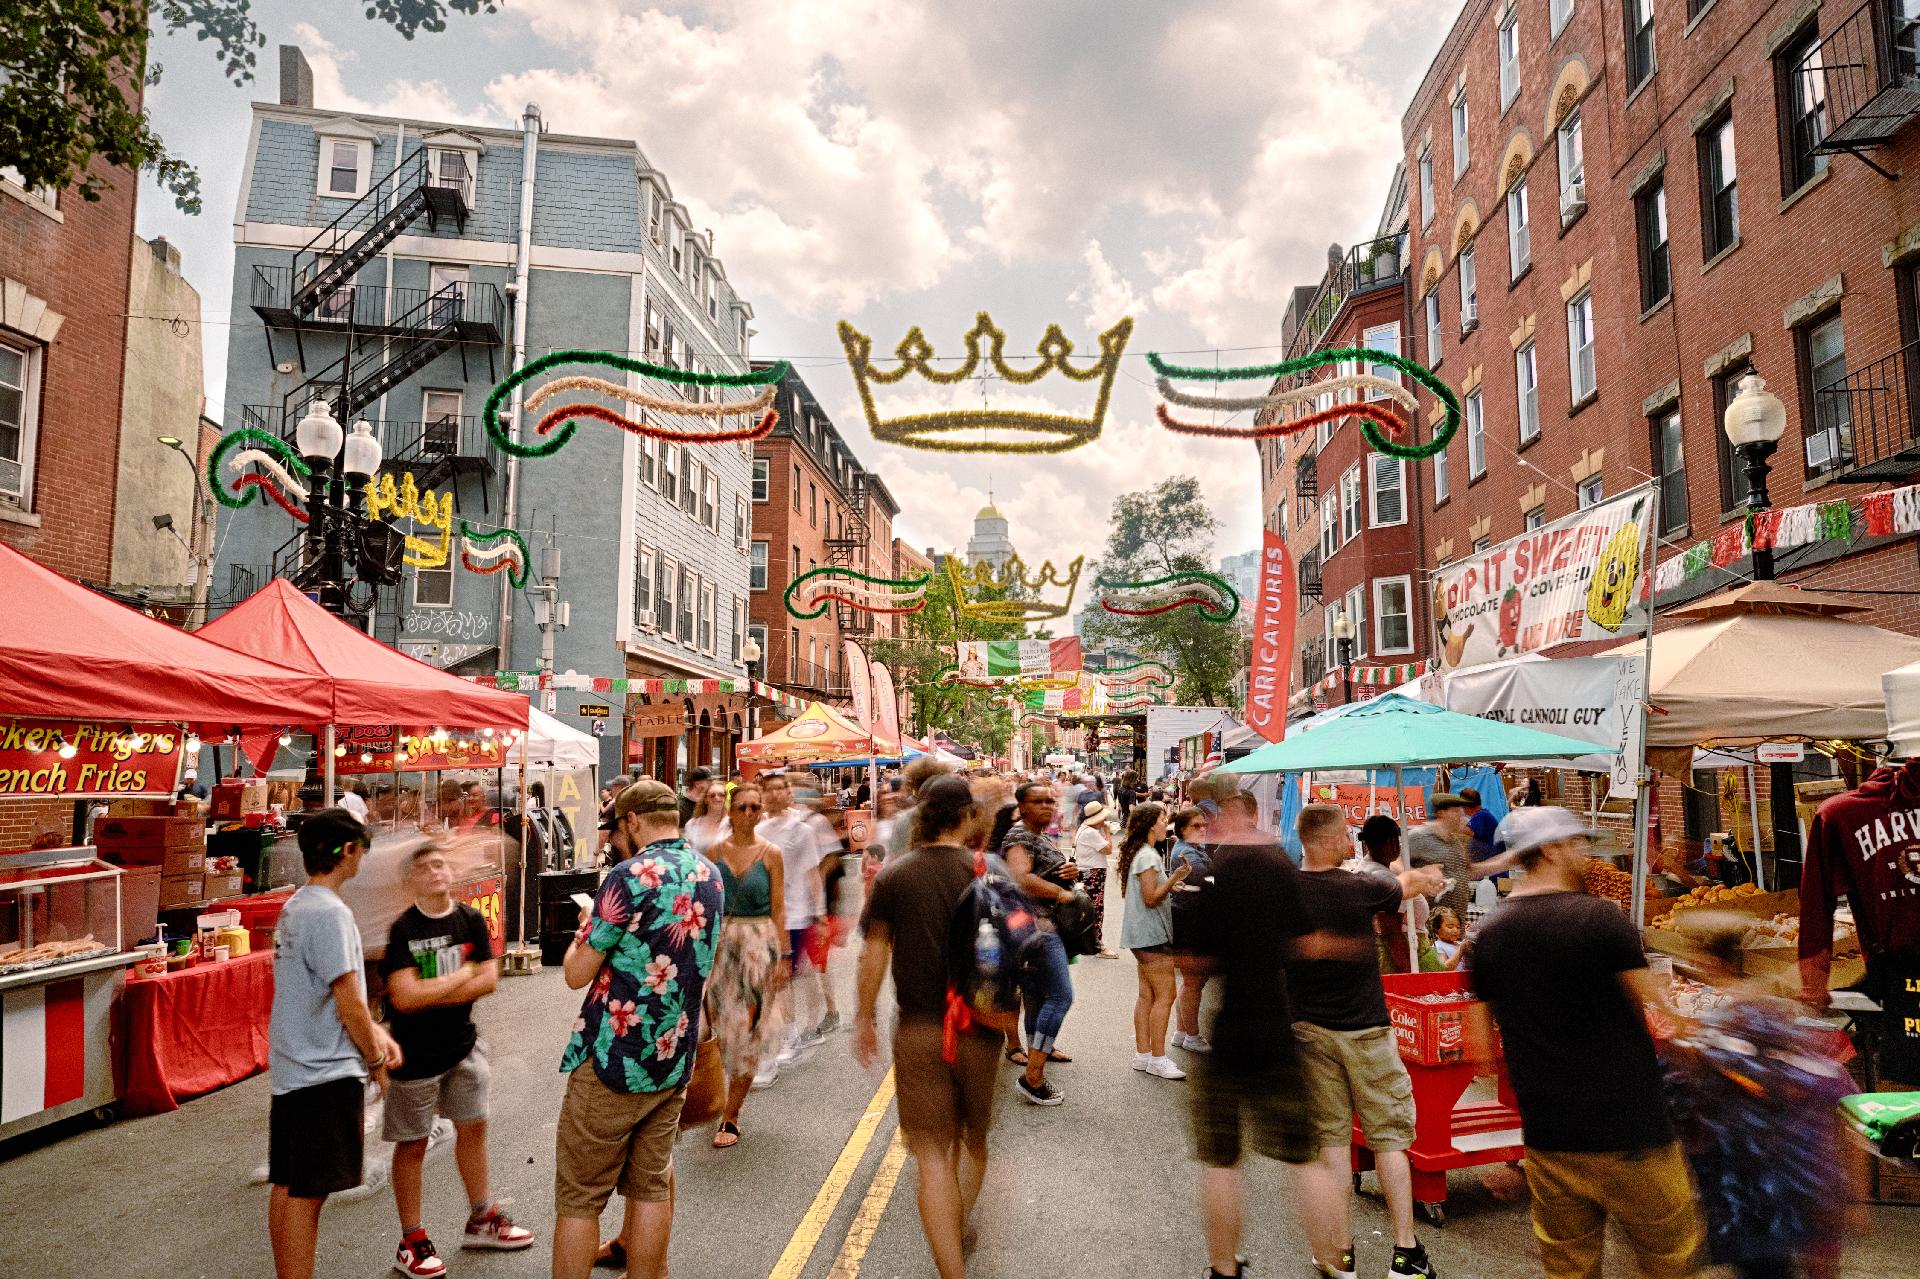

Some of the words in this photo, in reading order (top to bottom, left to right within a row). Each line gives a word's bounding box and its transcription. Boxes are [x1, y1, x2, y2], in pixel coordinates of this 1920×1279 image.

[1447, 567, 1477, 610] DIP
[1483, 549, 1507, 595] IT
[1513, 525, 1610, 585] SWEET
[1530, 566, 1590, 598] COVERED
[1253, 546, 1283, 727] CARICATURES
[1618, 658, 1636, 676] WE
[1615, 678, 1641, 701] TAKE
[638, 713, 682, 727] TABLE
[1520, 707, 1569, 725] CANNOLI
[1573, 707, 1606, 726] GUY
[71, 724, 175, 761] Fingers
[353, 725, 393, 739] DOGS
[1615, 704, 1634, 785] VENMO
[75, 763, 147, 793] Fries
[1390, 1008, 1417, 1028] Coke
